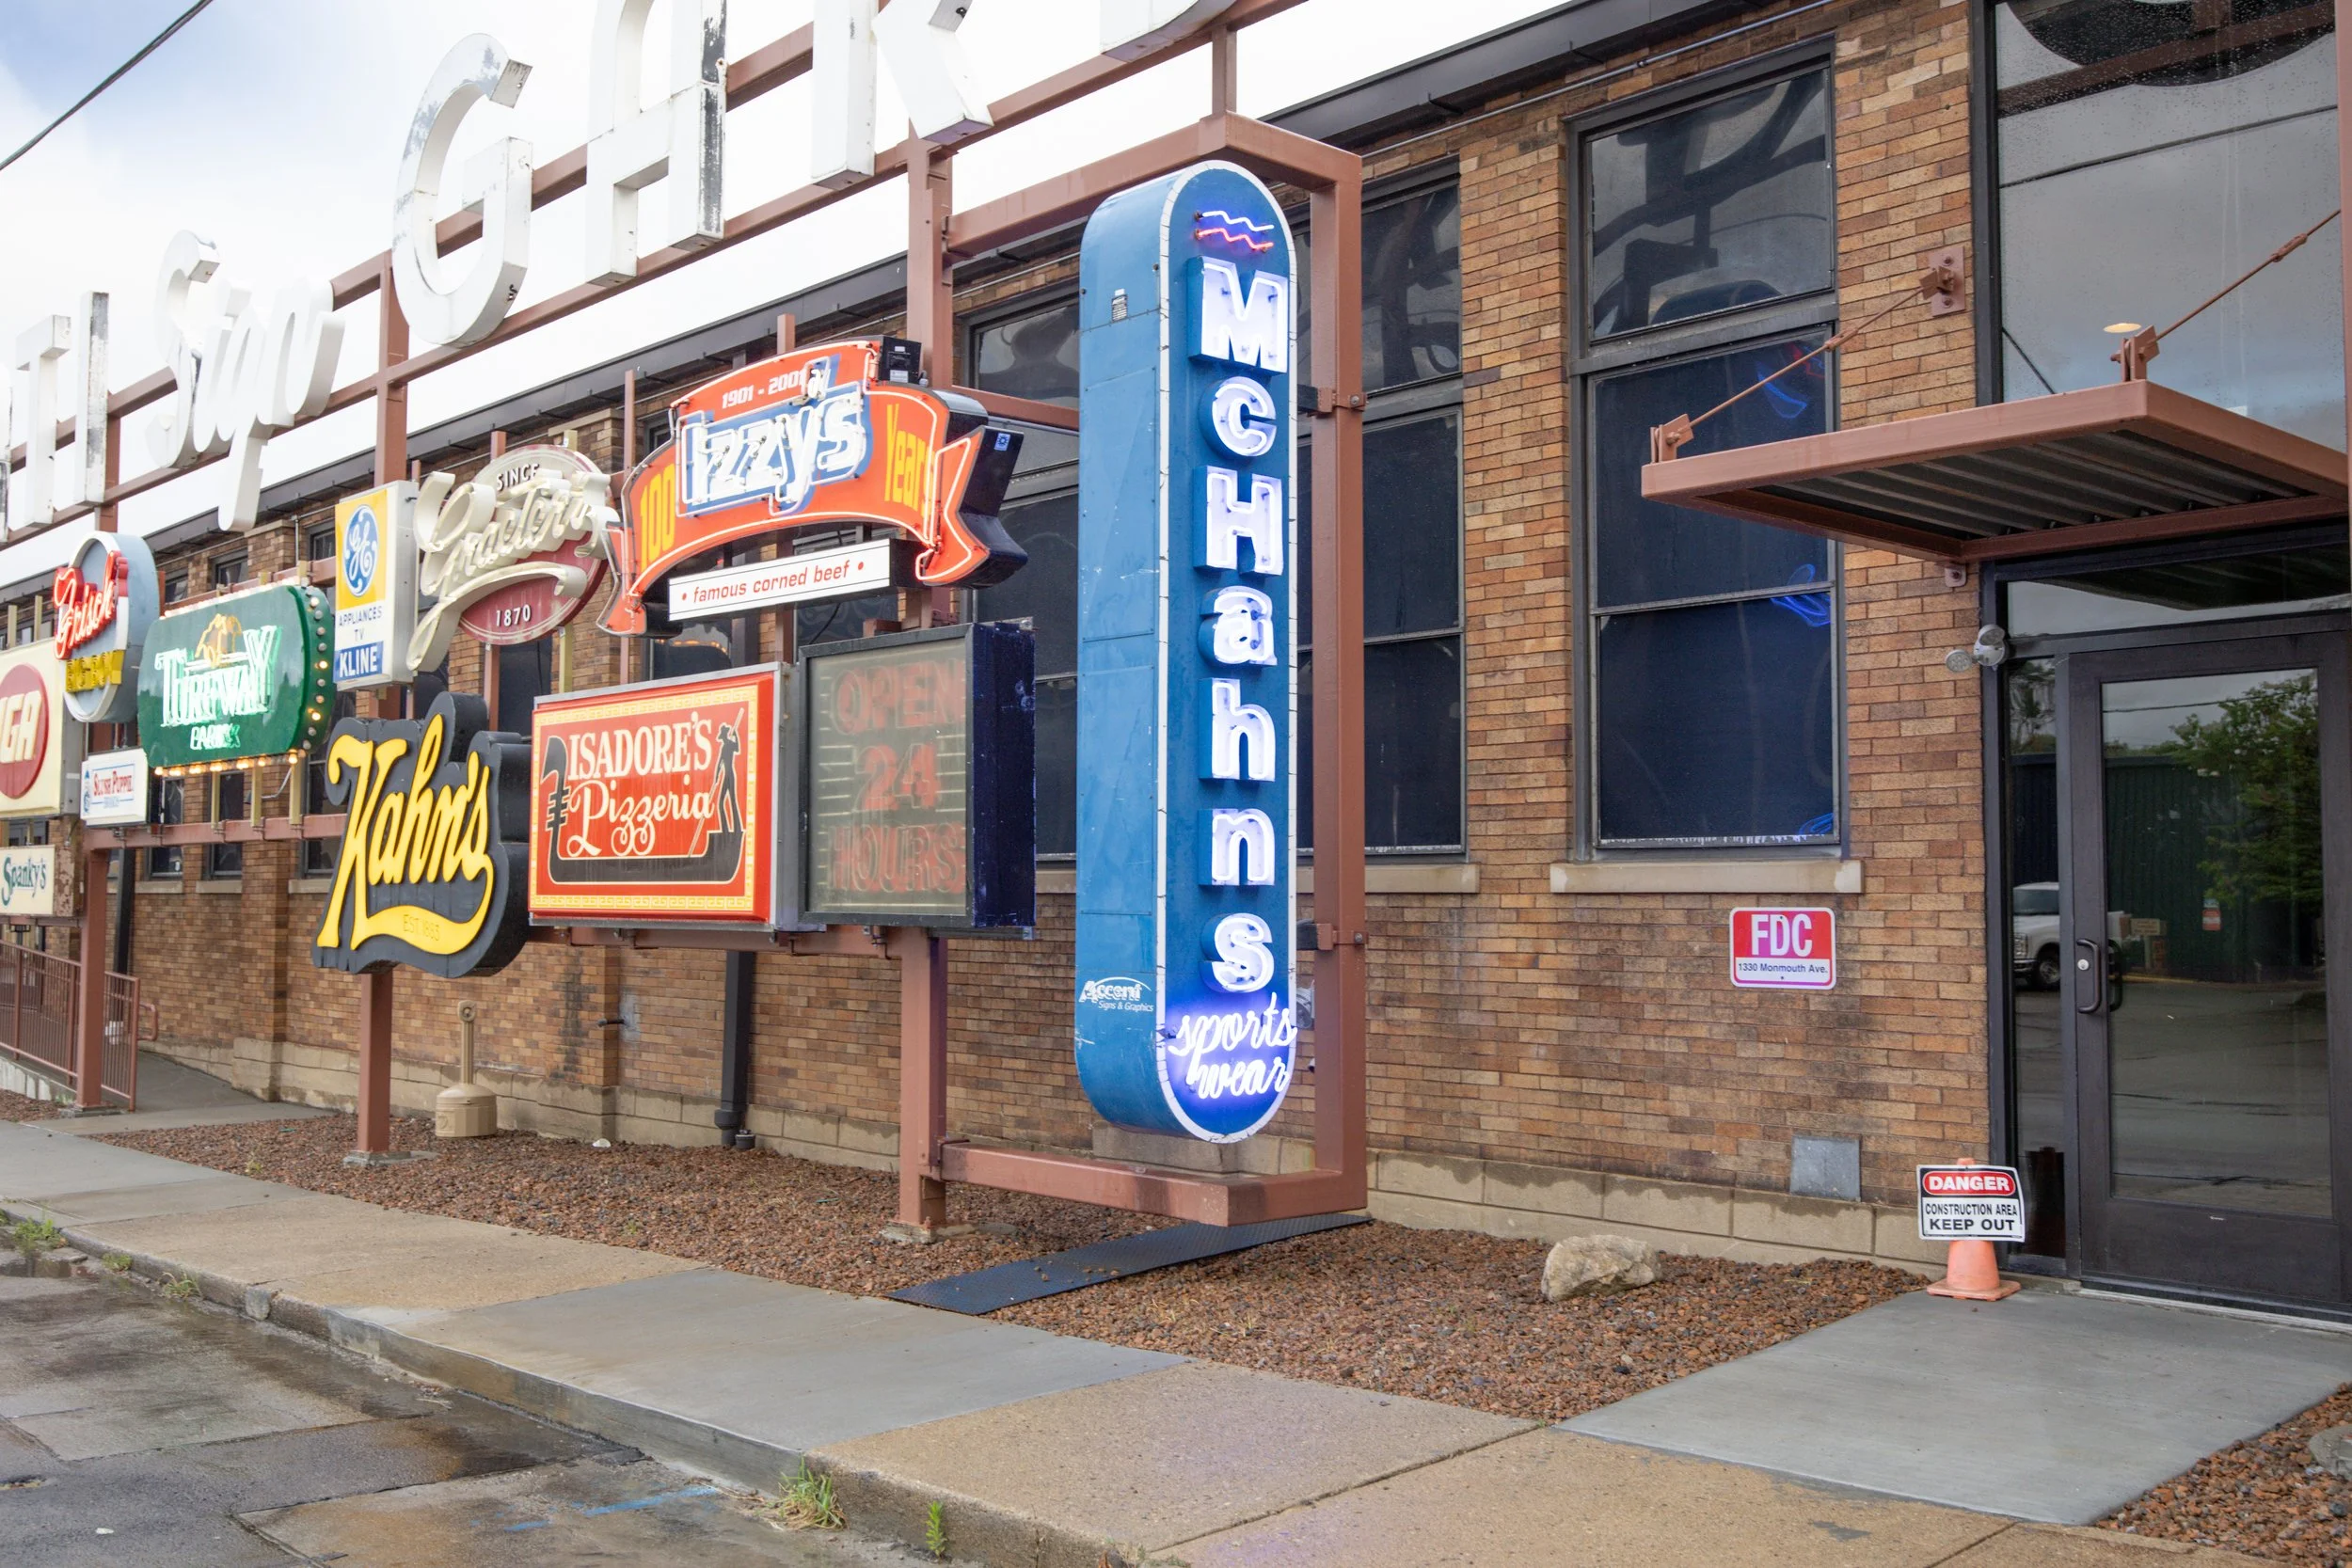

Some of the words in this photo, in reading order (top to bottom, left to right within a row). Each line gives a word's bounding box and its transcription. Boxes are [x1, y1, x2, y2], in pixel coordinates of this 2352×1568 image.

[722, 385, 755, 409] 1901
[496, 463, 540, 492] SINCE
[884, 403, 937, 519] Years
[640, 463, 676, 573] 100
[692, 582, 747, 603] famous
[753, 567, 807, 593] corned
[813, 560, 850, 583] beef
[339, 605, 383, 627] APPLIANCES
[354, 627, 365, 641] TV
[496, 604, 532, 627] 1870
[339, 645, 378, 678] KLINE
[832, 658, 967, 736] OPEN
[566, 711, 713, 782] ISADORE'S
[850, 741, 942, 815] 24
[317, 713, 494, 955] Kahn's
[565, 776, 715, 857] Pizzeria
[828, 820, 967, 894] HOURS
[1, 856, 47, 907] Spanky's
[1751, 913, 1813, 957] FDC
[1738, 963, 1758, 972] 1330
[1760, 963, 1806, 973] Monmouth
[1808, 964, 1828, 974] Ave.
[1078, 980, 1143, 1004] Accent
[1098, 1001, 1117, 1011] Signs
[1124, 1003, 1154, 1013] Graphics
[1167, 991, 1298, 1085] sports
[1197, 1056, 1292, 1100] wear
[1928, 1176, 2010, 1191] DANGER
[1925, 1203, 1993, 1215] CONSTRUCTION
[1995, 1204, 2018, 1216] AREA
[1930, 1218, 1975, 1230] KEEP
[1981, 1218, 2015, 1231] OUT
